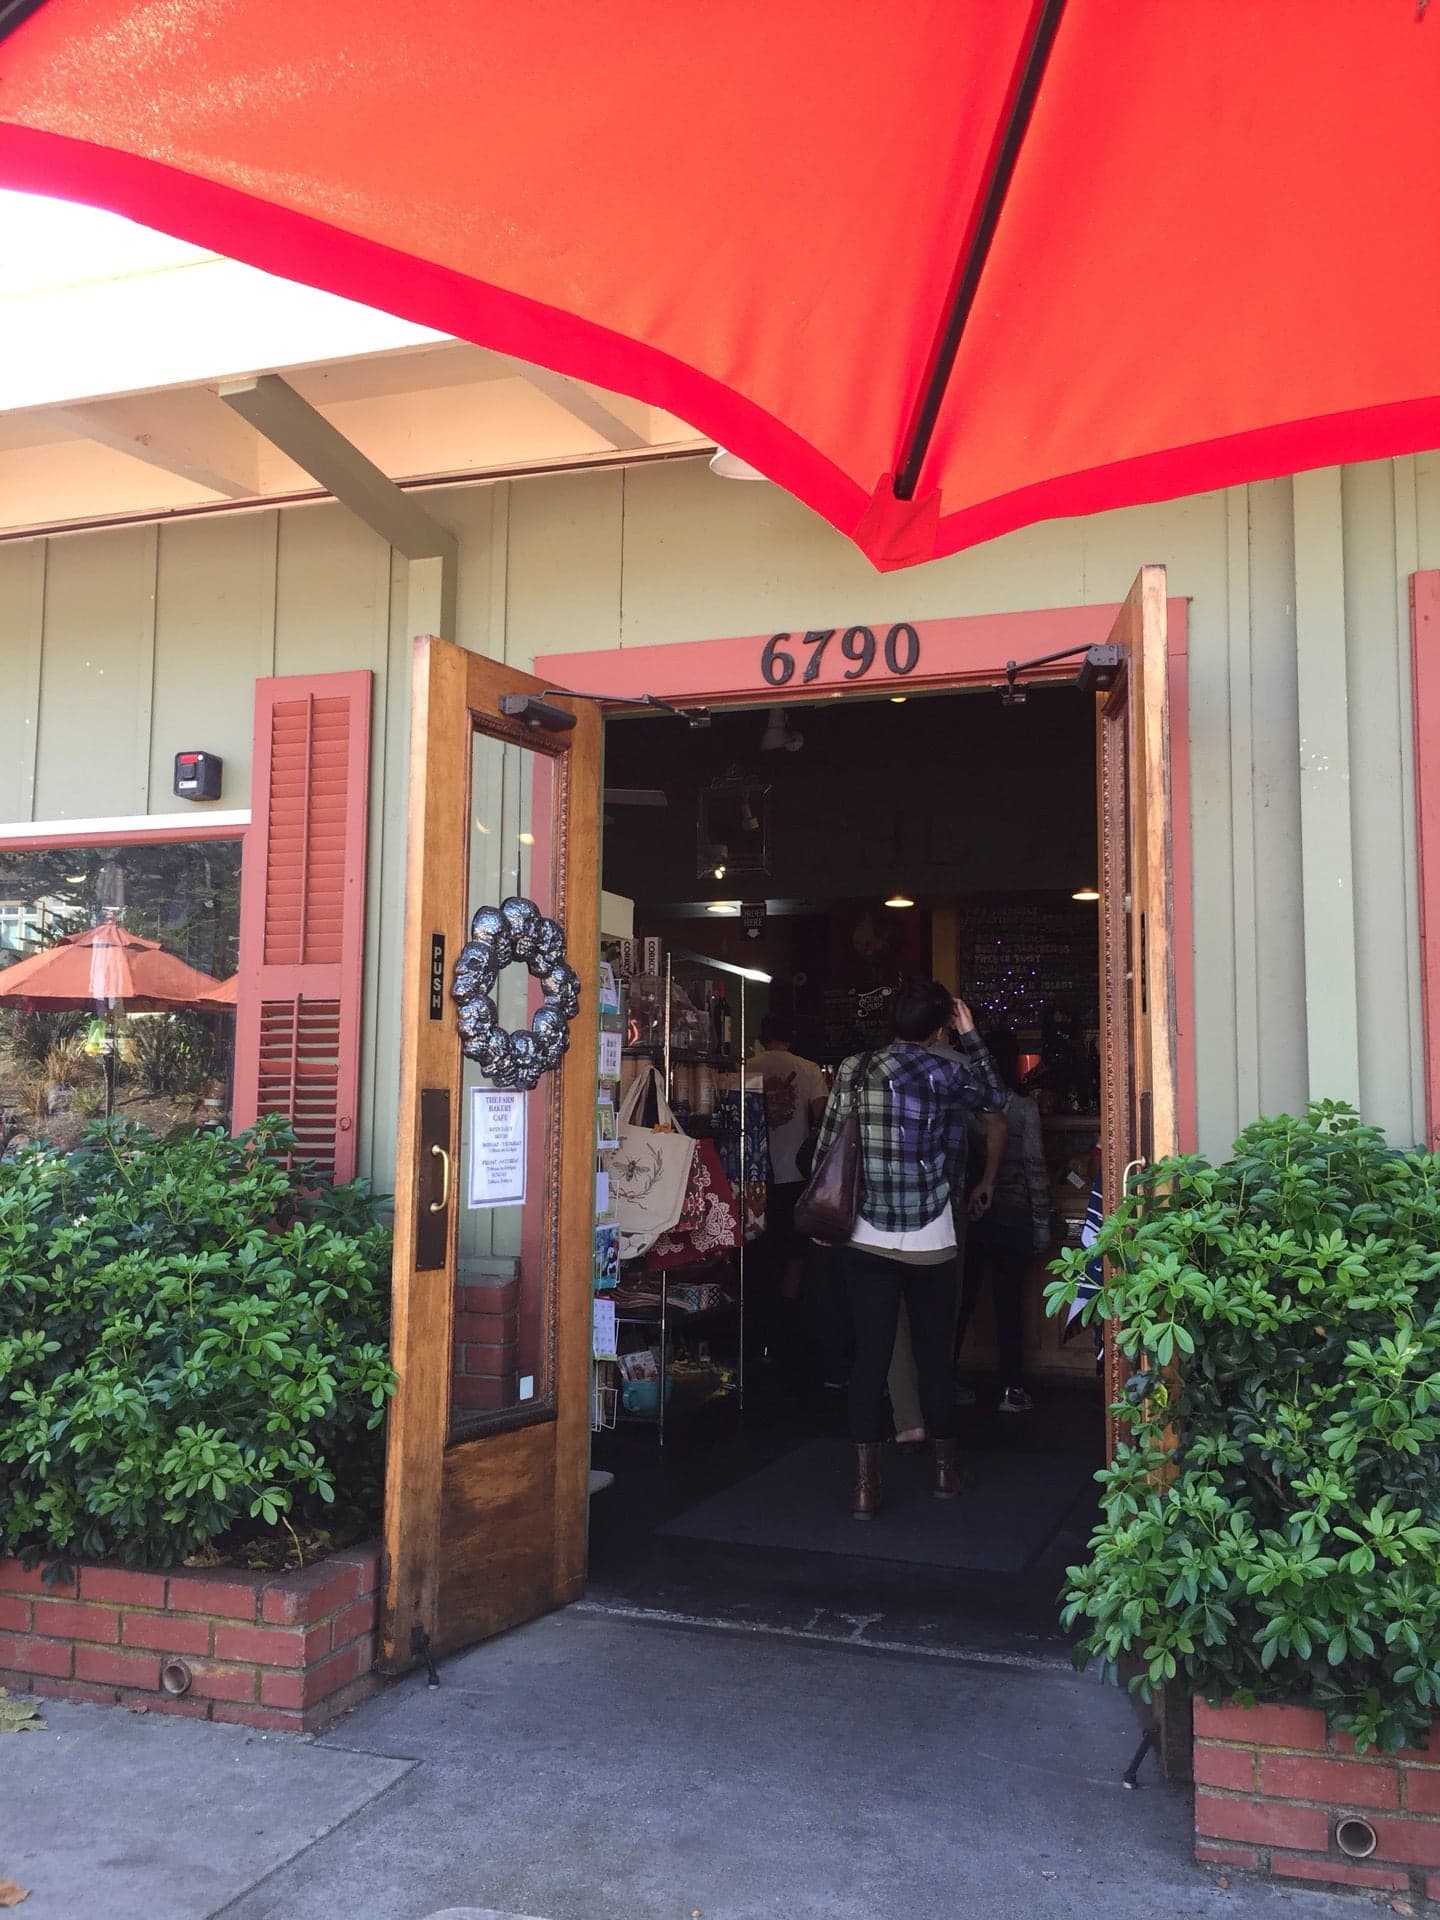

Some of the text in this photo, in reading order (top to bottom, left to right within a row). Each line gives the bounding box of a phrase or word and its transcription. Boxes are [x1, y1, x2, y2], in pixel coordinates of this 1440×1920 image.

[761, 622, 920, 686] 6790
[744, 918, 762, 927] HERE
[432, 946, 442, 1008] PUSH
[486, 1096, 497, 1104] THE
[488, 1104, 512, 1112] BAKERY
